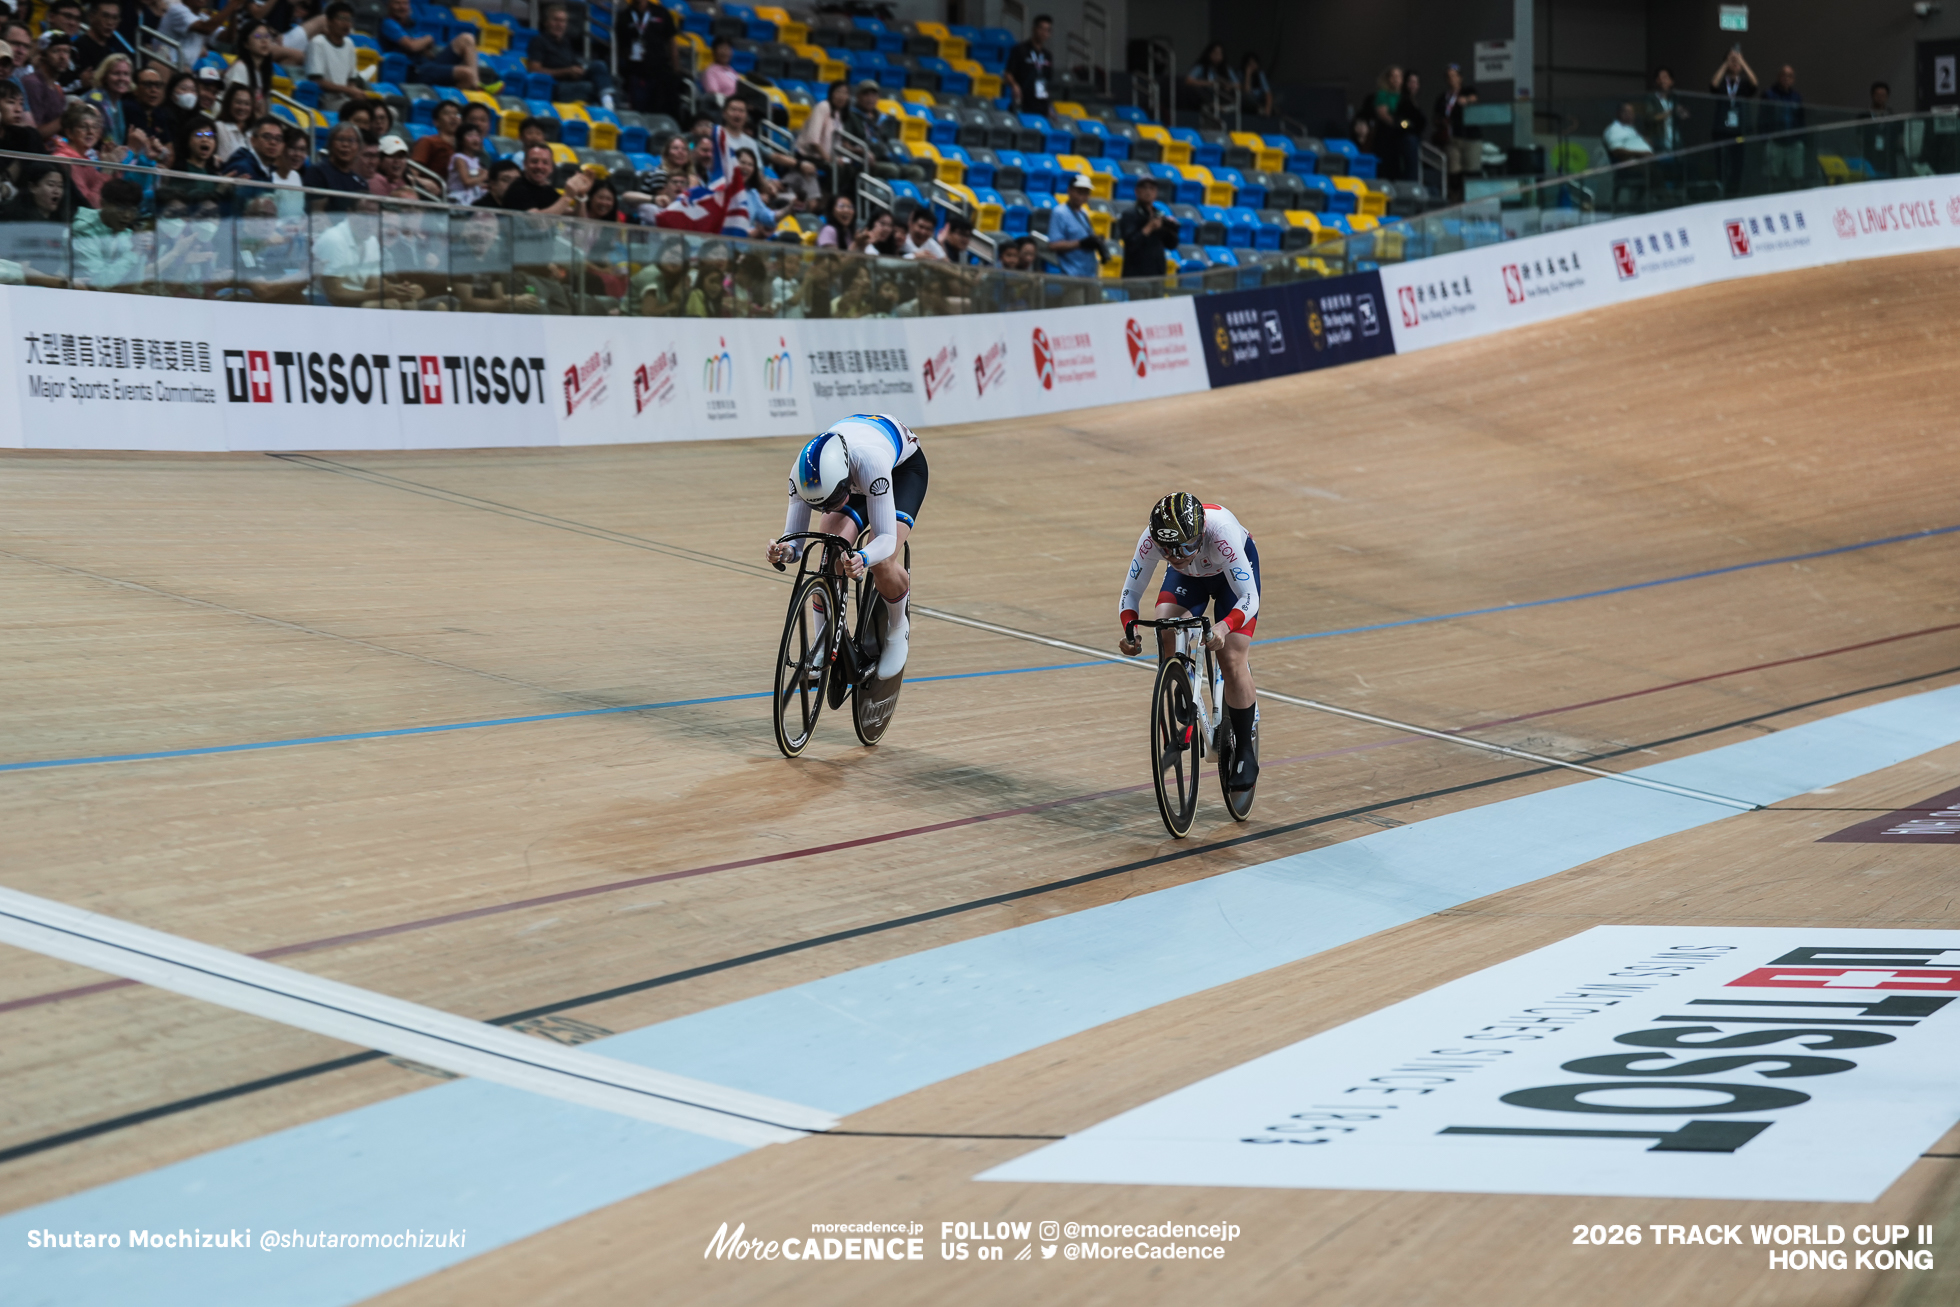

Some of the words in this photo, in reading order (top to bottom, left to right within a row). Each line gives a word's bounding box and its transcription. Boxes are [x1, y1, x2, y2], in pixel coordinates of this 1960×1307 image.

[1857, 204, 1900, 235] LAW'S
[1899, 199, 1941, 230] CYCLE
[28, 374, 66, 403] Major
[69, 376, 111, 405] Sports
[112, 378, 153, 401] Events
[155, 380, 216, 404] Committee
[273, 351, 391, 405] TISSOT
[443, 356, 546, 405] TISSOT
[833, 591, 848, 653] LOTUS
[1608, 944, 1738, 978] SWISS
[1463, 983, 1659, 1042] WATCHES
[1343, 1047, 1514, 1096] SINCE
[1434, 994, 1960, 1154] TISSOT
[1239, 1104, 1400, 1145] 1853
